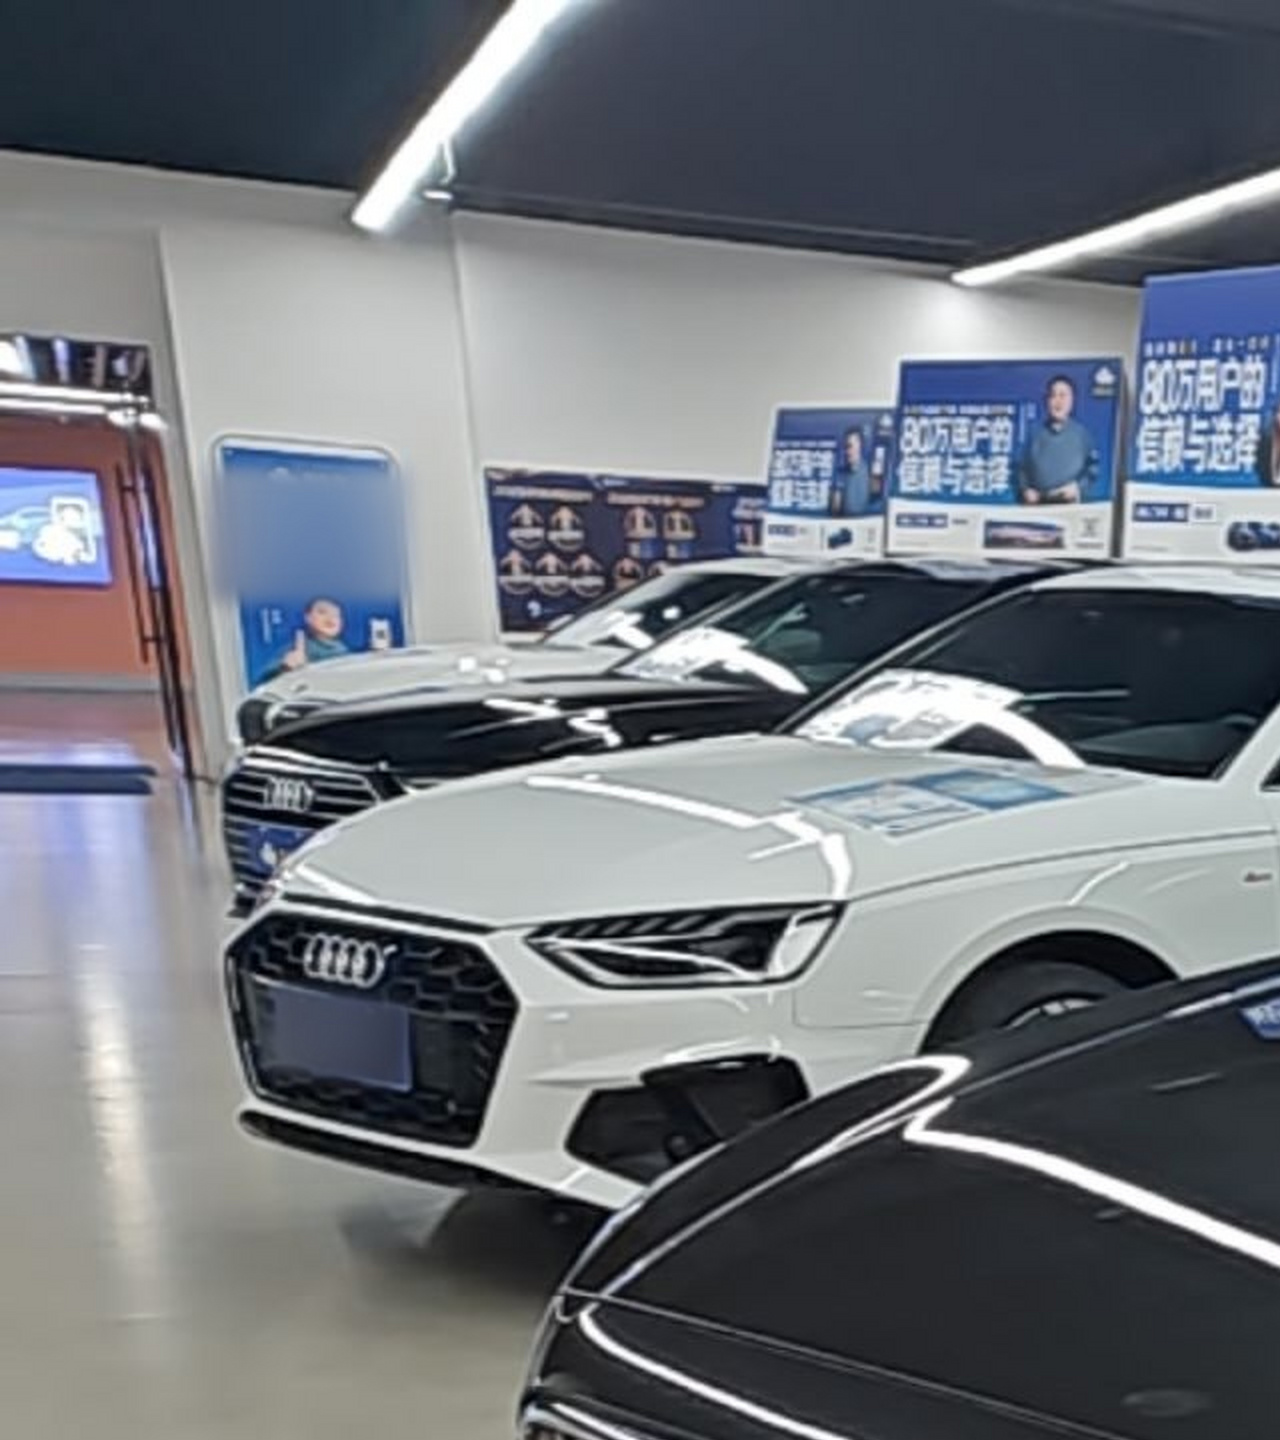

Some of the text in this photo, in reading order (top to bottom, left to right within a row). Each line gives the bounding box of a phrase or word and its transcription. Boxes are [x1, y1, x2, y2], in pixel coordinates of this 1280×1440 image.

[1140, 354, 1267, 415] 80万用户的
[900, 415, 1013, 453] 80万用户的
[1136, 413, 1261, 474] 信赖与选择
